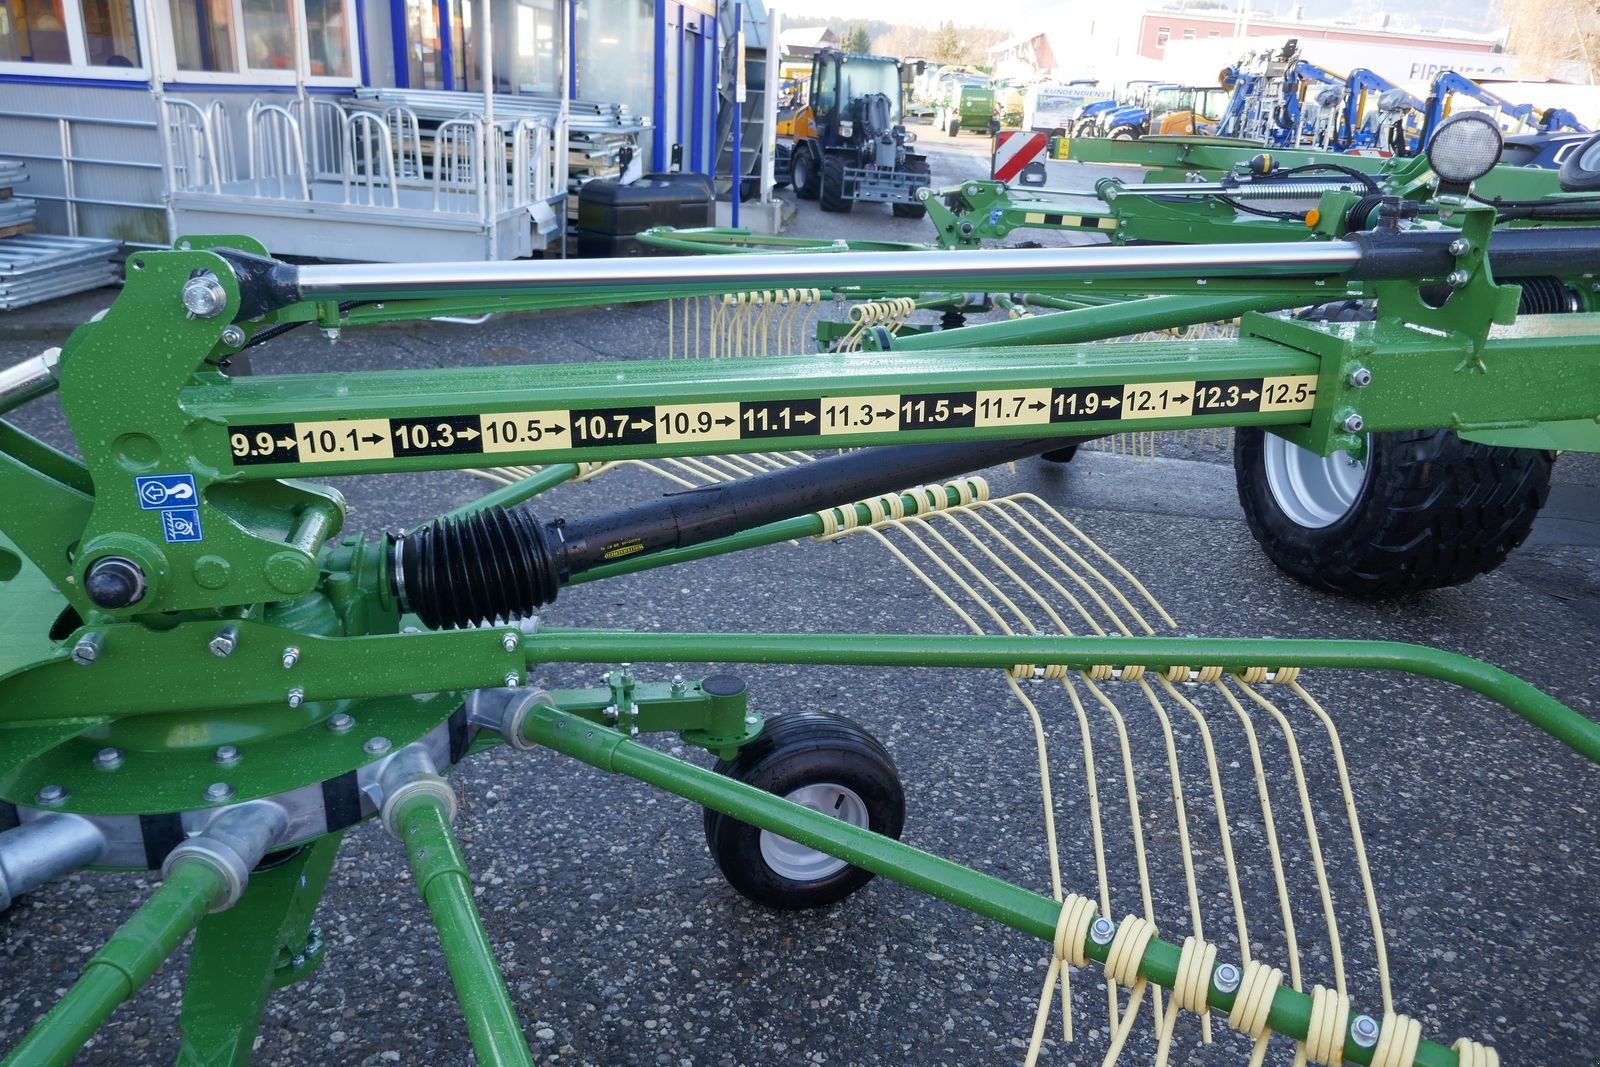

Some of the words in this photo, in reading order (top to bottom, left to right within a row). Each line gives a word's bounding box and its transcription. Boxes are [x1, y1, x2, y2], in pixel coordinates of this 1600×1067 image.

[1044, 88, 1111, 97] KUNDENDIENST
[231, 432, 275, 457] 9.9
[303, 429, 360, 453] 10.1
[396, 425, 454, 449] 10.3
[487, 420, 542, 444] 10.5
[576, 415, 630, 440] 10.7
[661, 411, 712, 435] 10.9
[744, 408, 791, 432] 11.1
[827, 405, 874, 427] 11.3
[902, 400, 950, 423] 11.5
[981, 397, 1026, 419] 11.7
[1056, 393, 1099, 416] 11.9
[1127, 390, 1169, 411] 12.1
[1196, 386, 1240, 408] 12.3
[1266, 383, 1308, 404] 12.5
